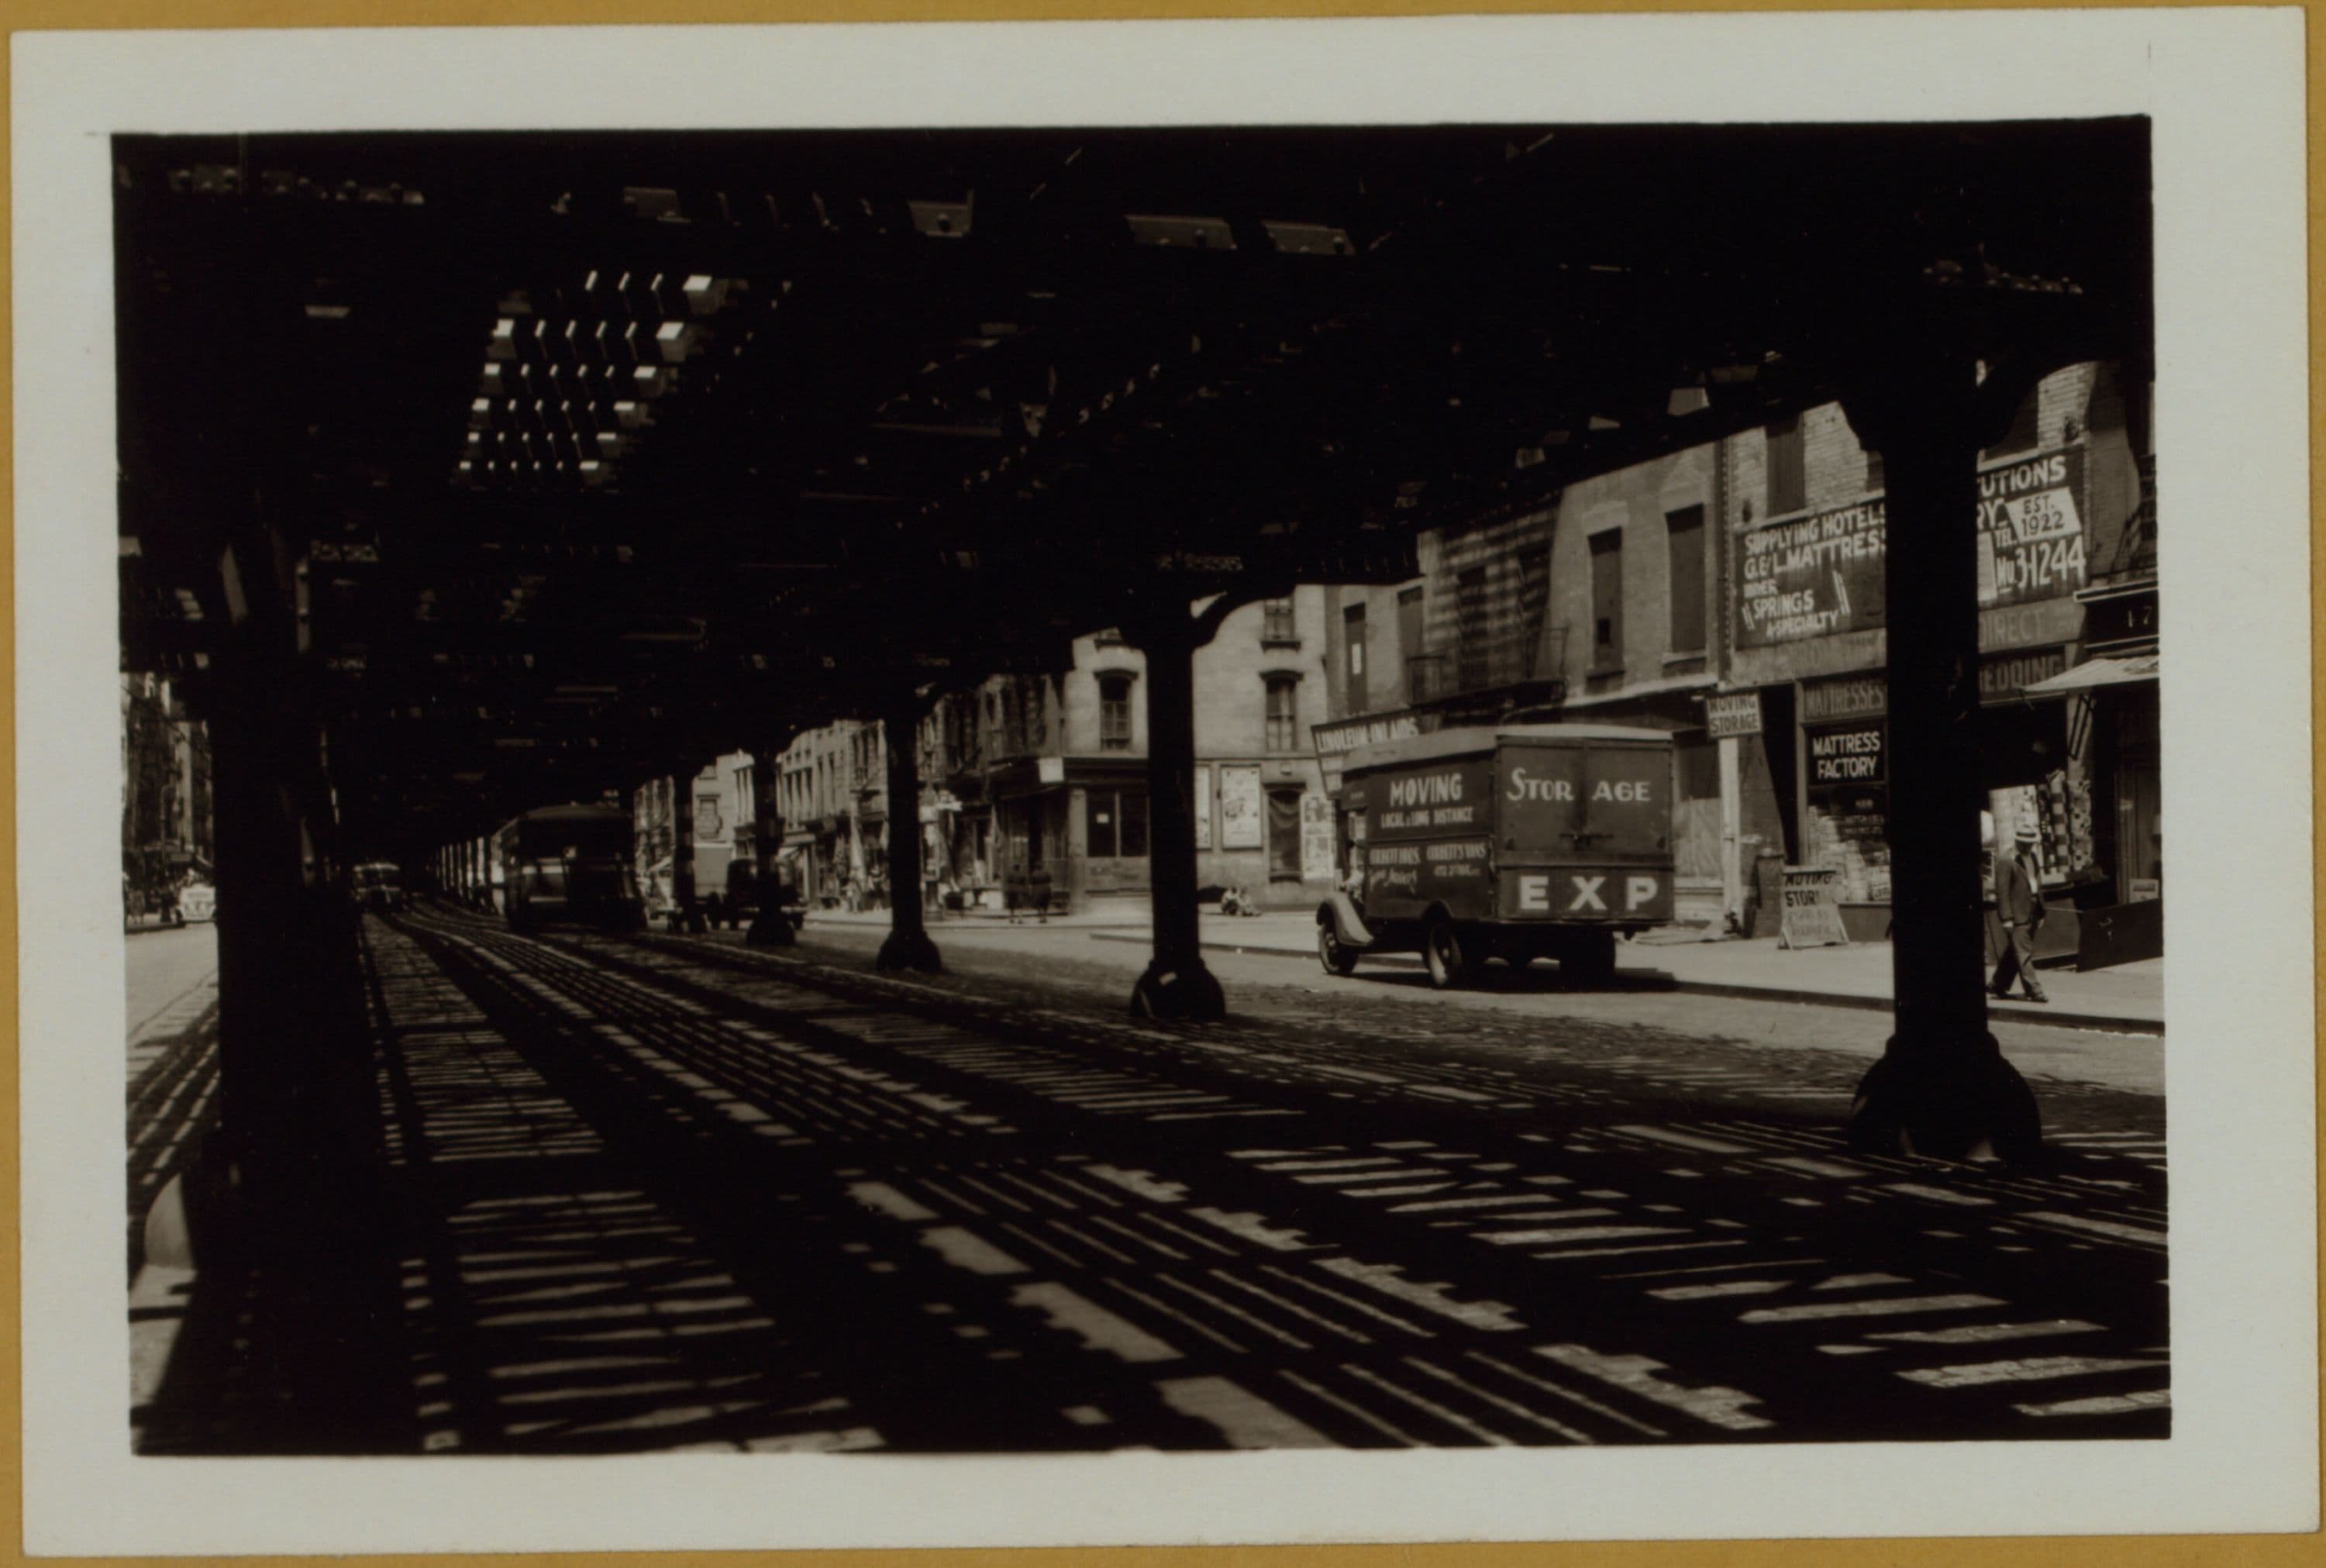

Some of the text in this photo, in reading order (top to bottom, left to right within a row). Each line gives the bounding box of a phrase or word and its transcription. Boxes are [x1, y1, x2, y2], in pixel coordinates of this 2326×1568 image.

[2021, 511, 2065, 536] 1922
[1744, 519, 1820, 556] SUPPLYING
[1753, 589, 1815, 620] SPRINGS
[1710, 696, 1756, 713] MOVING
[1711, 713, 1759, 735] STORAGE
[1812, 732, 1881, 756] MATTRESS
[1817, 756, 1878, 780] FACTORY
[1390, 772, 1463, 808] MOVING
[1380, 812, 1404, 829] LOCAL
[1434, 806, 1474, 825] DISTANCE
